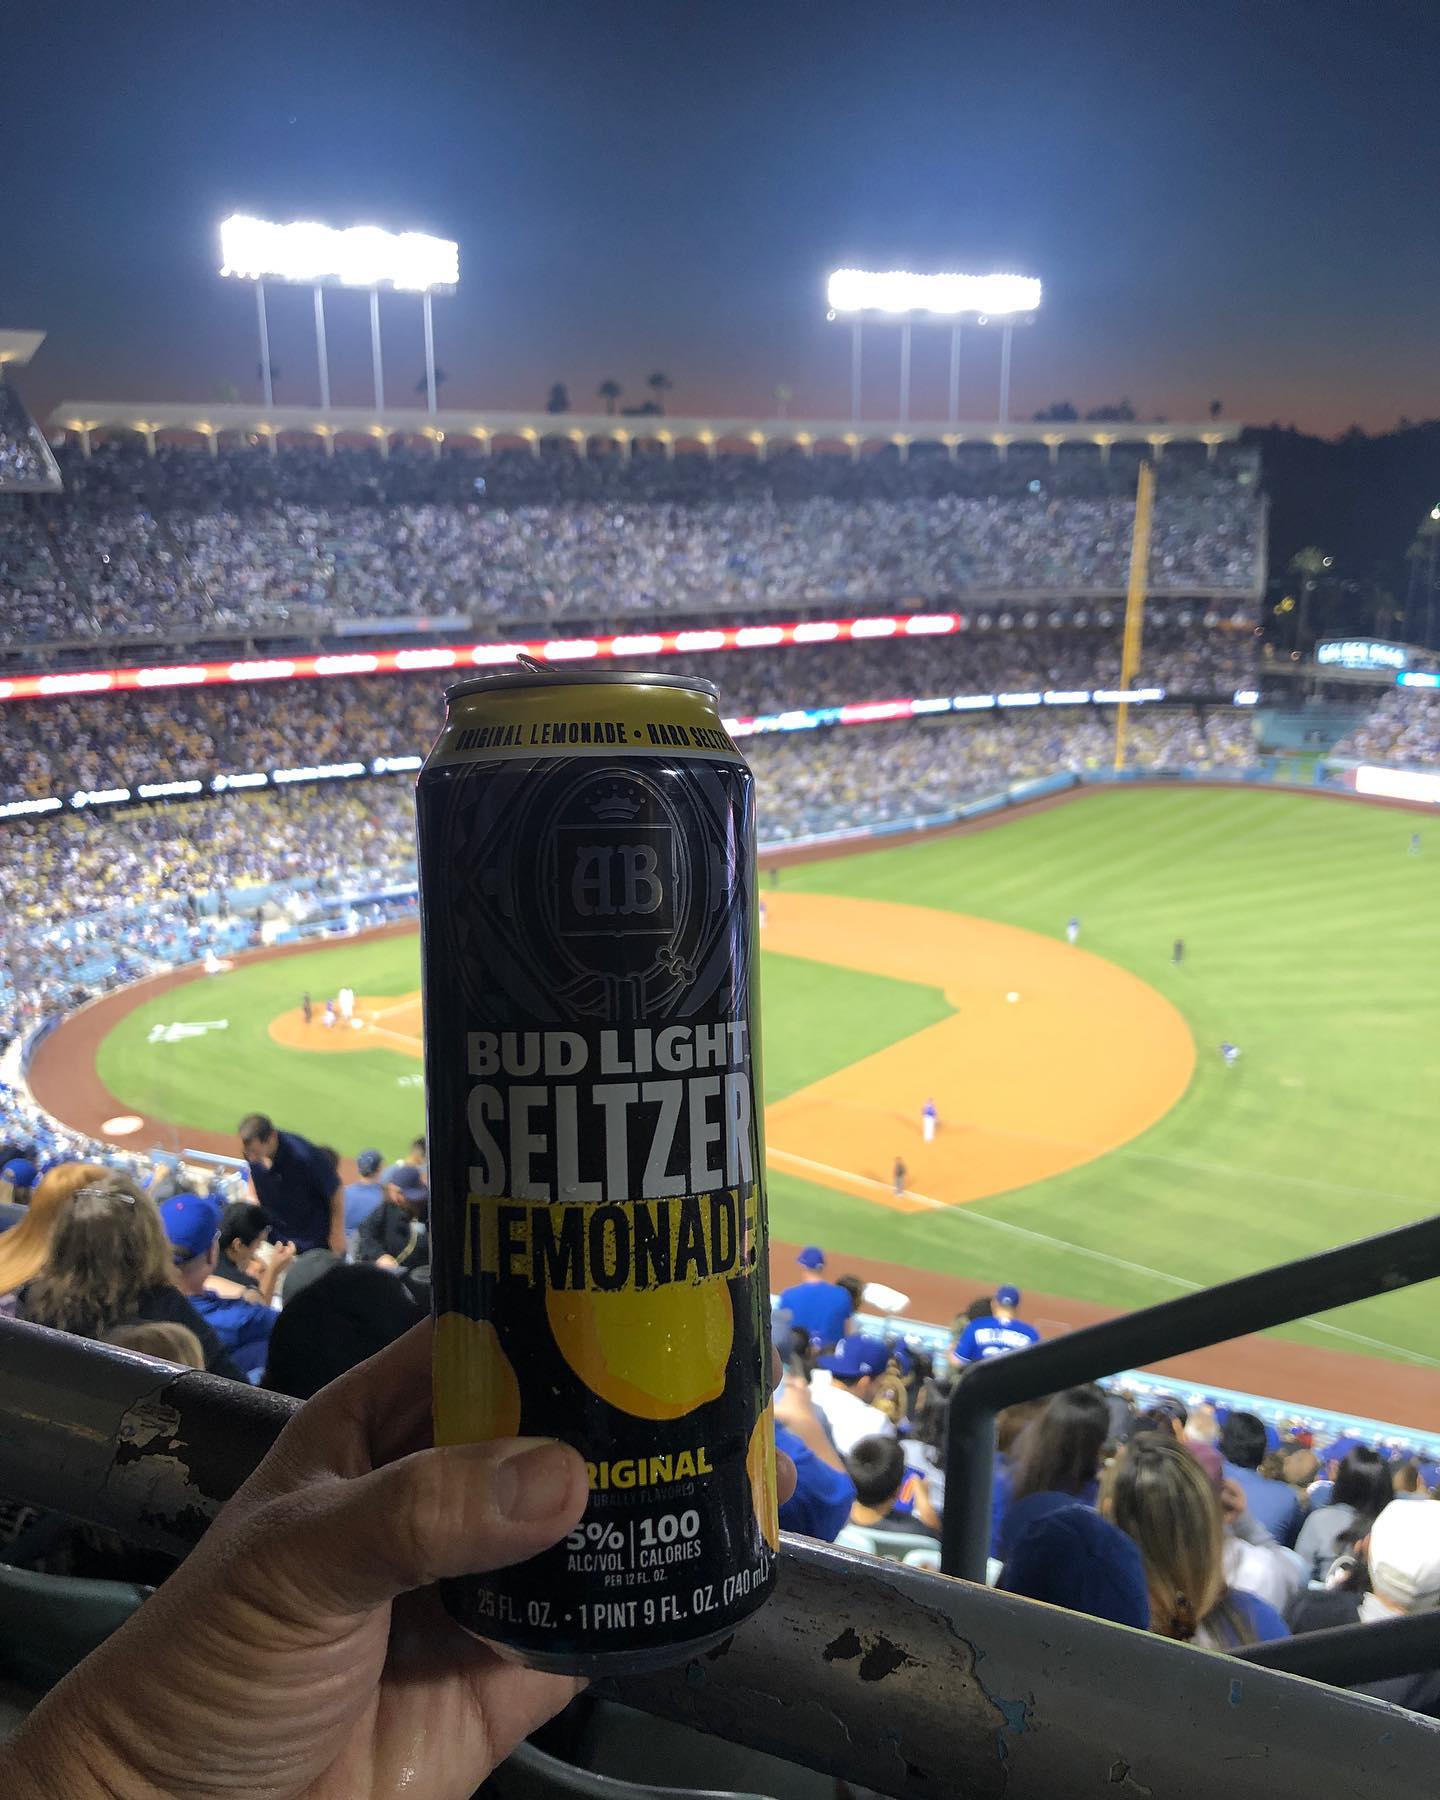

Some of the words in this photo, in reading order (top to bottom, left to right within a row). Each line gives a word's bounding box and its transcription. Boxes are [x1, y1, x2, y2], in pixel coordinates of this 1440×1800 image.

[455, 724, 523, 752] ORIGINAL
[530, 721, 628, 745] LEMONADE
[646, 722, 691, 747] HARD
[571, 843, 665, 918] AB
[467, 1030, 590, 1077] BUD
[600, 1019, 748, 1073] LIGHT
[466, 1070, 752, 1201] SELTZER
[464, 1186, 759, 1293] LEMONADE
[585, 1446, 714, 1490] RIGINAL
[566, 1521, 625, 1551] 5%
[640, 1509, 700, 1547] 100
[567, 1553, 625, 1572] ALC/VOL
[640, 1539, 702, 1568] CALORIES
[604, 1574, 622, 1587] PER
[625, 1573, 635, 1585] 12
[637, 1571, 651, 1584] FL.
[653, 1568, 668, 1582] OZ.
[478, 1588, 495, 1618] 25
[498, 1595, 523, 1624] FL.
[527, 1600, 558, 1629] OZ.
[579, 1603, 588, 1630] 1
[593, 1601, 638, 1631] PINT
[644, 1599, 655, 1626] 9
[661, 1594, 688, 1623] FL.
[692, 1584, 719, 1615] OZ.
[723, 1568, 751, 1606] (740
